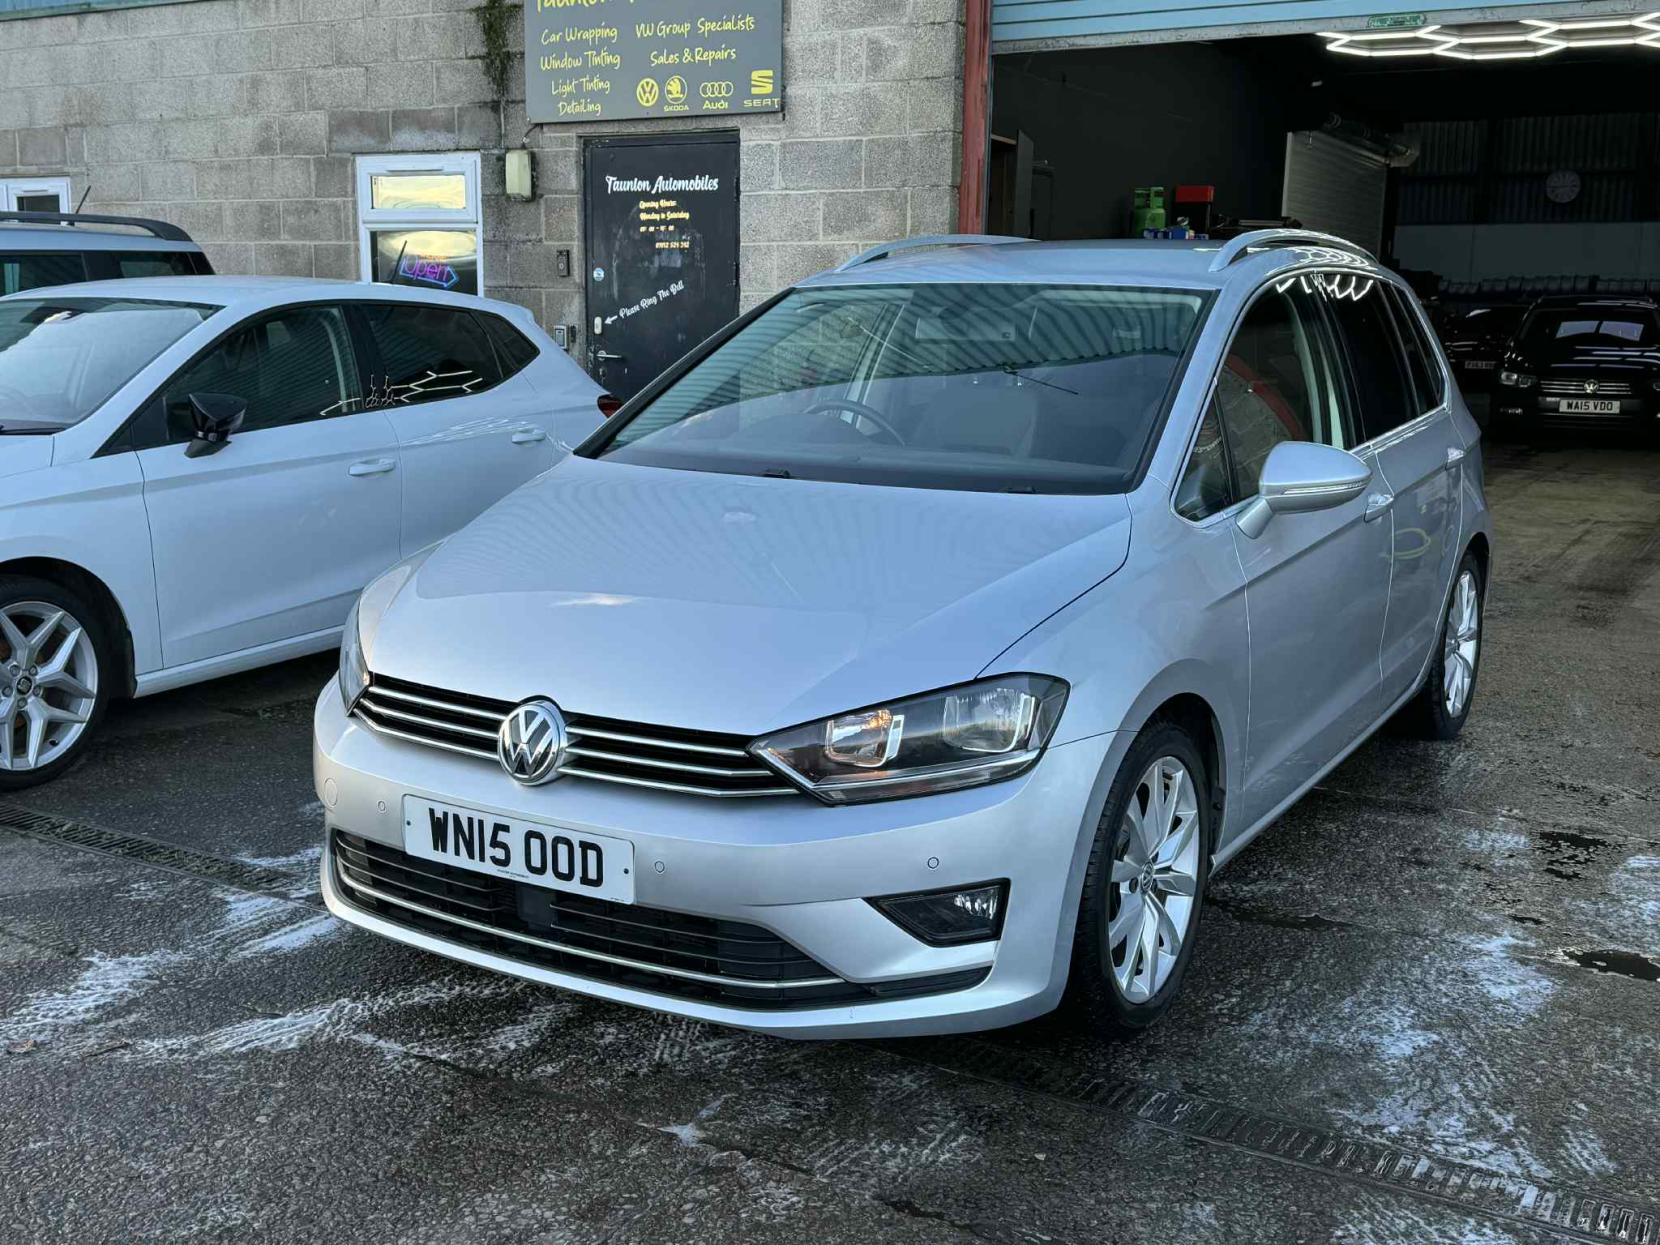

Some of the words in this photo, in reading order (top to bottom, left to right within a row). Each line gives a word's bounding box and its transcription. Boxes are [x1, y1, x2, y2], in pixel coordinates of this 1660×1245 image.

[541, 29, 562, 45] Car
[565, 21, 618, 45] Wrapping
[636, 23, 654, 38] VW
[656, 21, 691, 38] Group
[697, 14, 755, 37] Specialists
[540, 51, 583, 71] Window
[583, 46, 621, 70] Tinting
[650, 49, 680, 67] Sales
[682, 47, 694, 63] &
[694, 44, 737, 67] Repairs
[551, 78, 579, 97] Light
[579, 74, 610, 95] Tinting
[558, 98, 602, 117] Detailing
[702, 100, 729, 110] Audi
[743, 98, 780, 108] SEAT
[605, 175, 651, 194] Taunton
[651, 174, 719, 194] Automobiles
[656, 289, 670, 301] The
[428, 807, 512, 868] WN15
